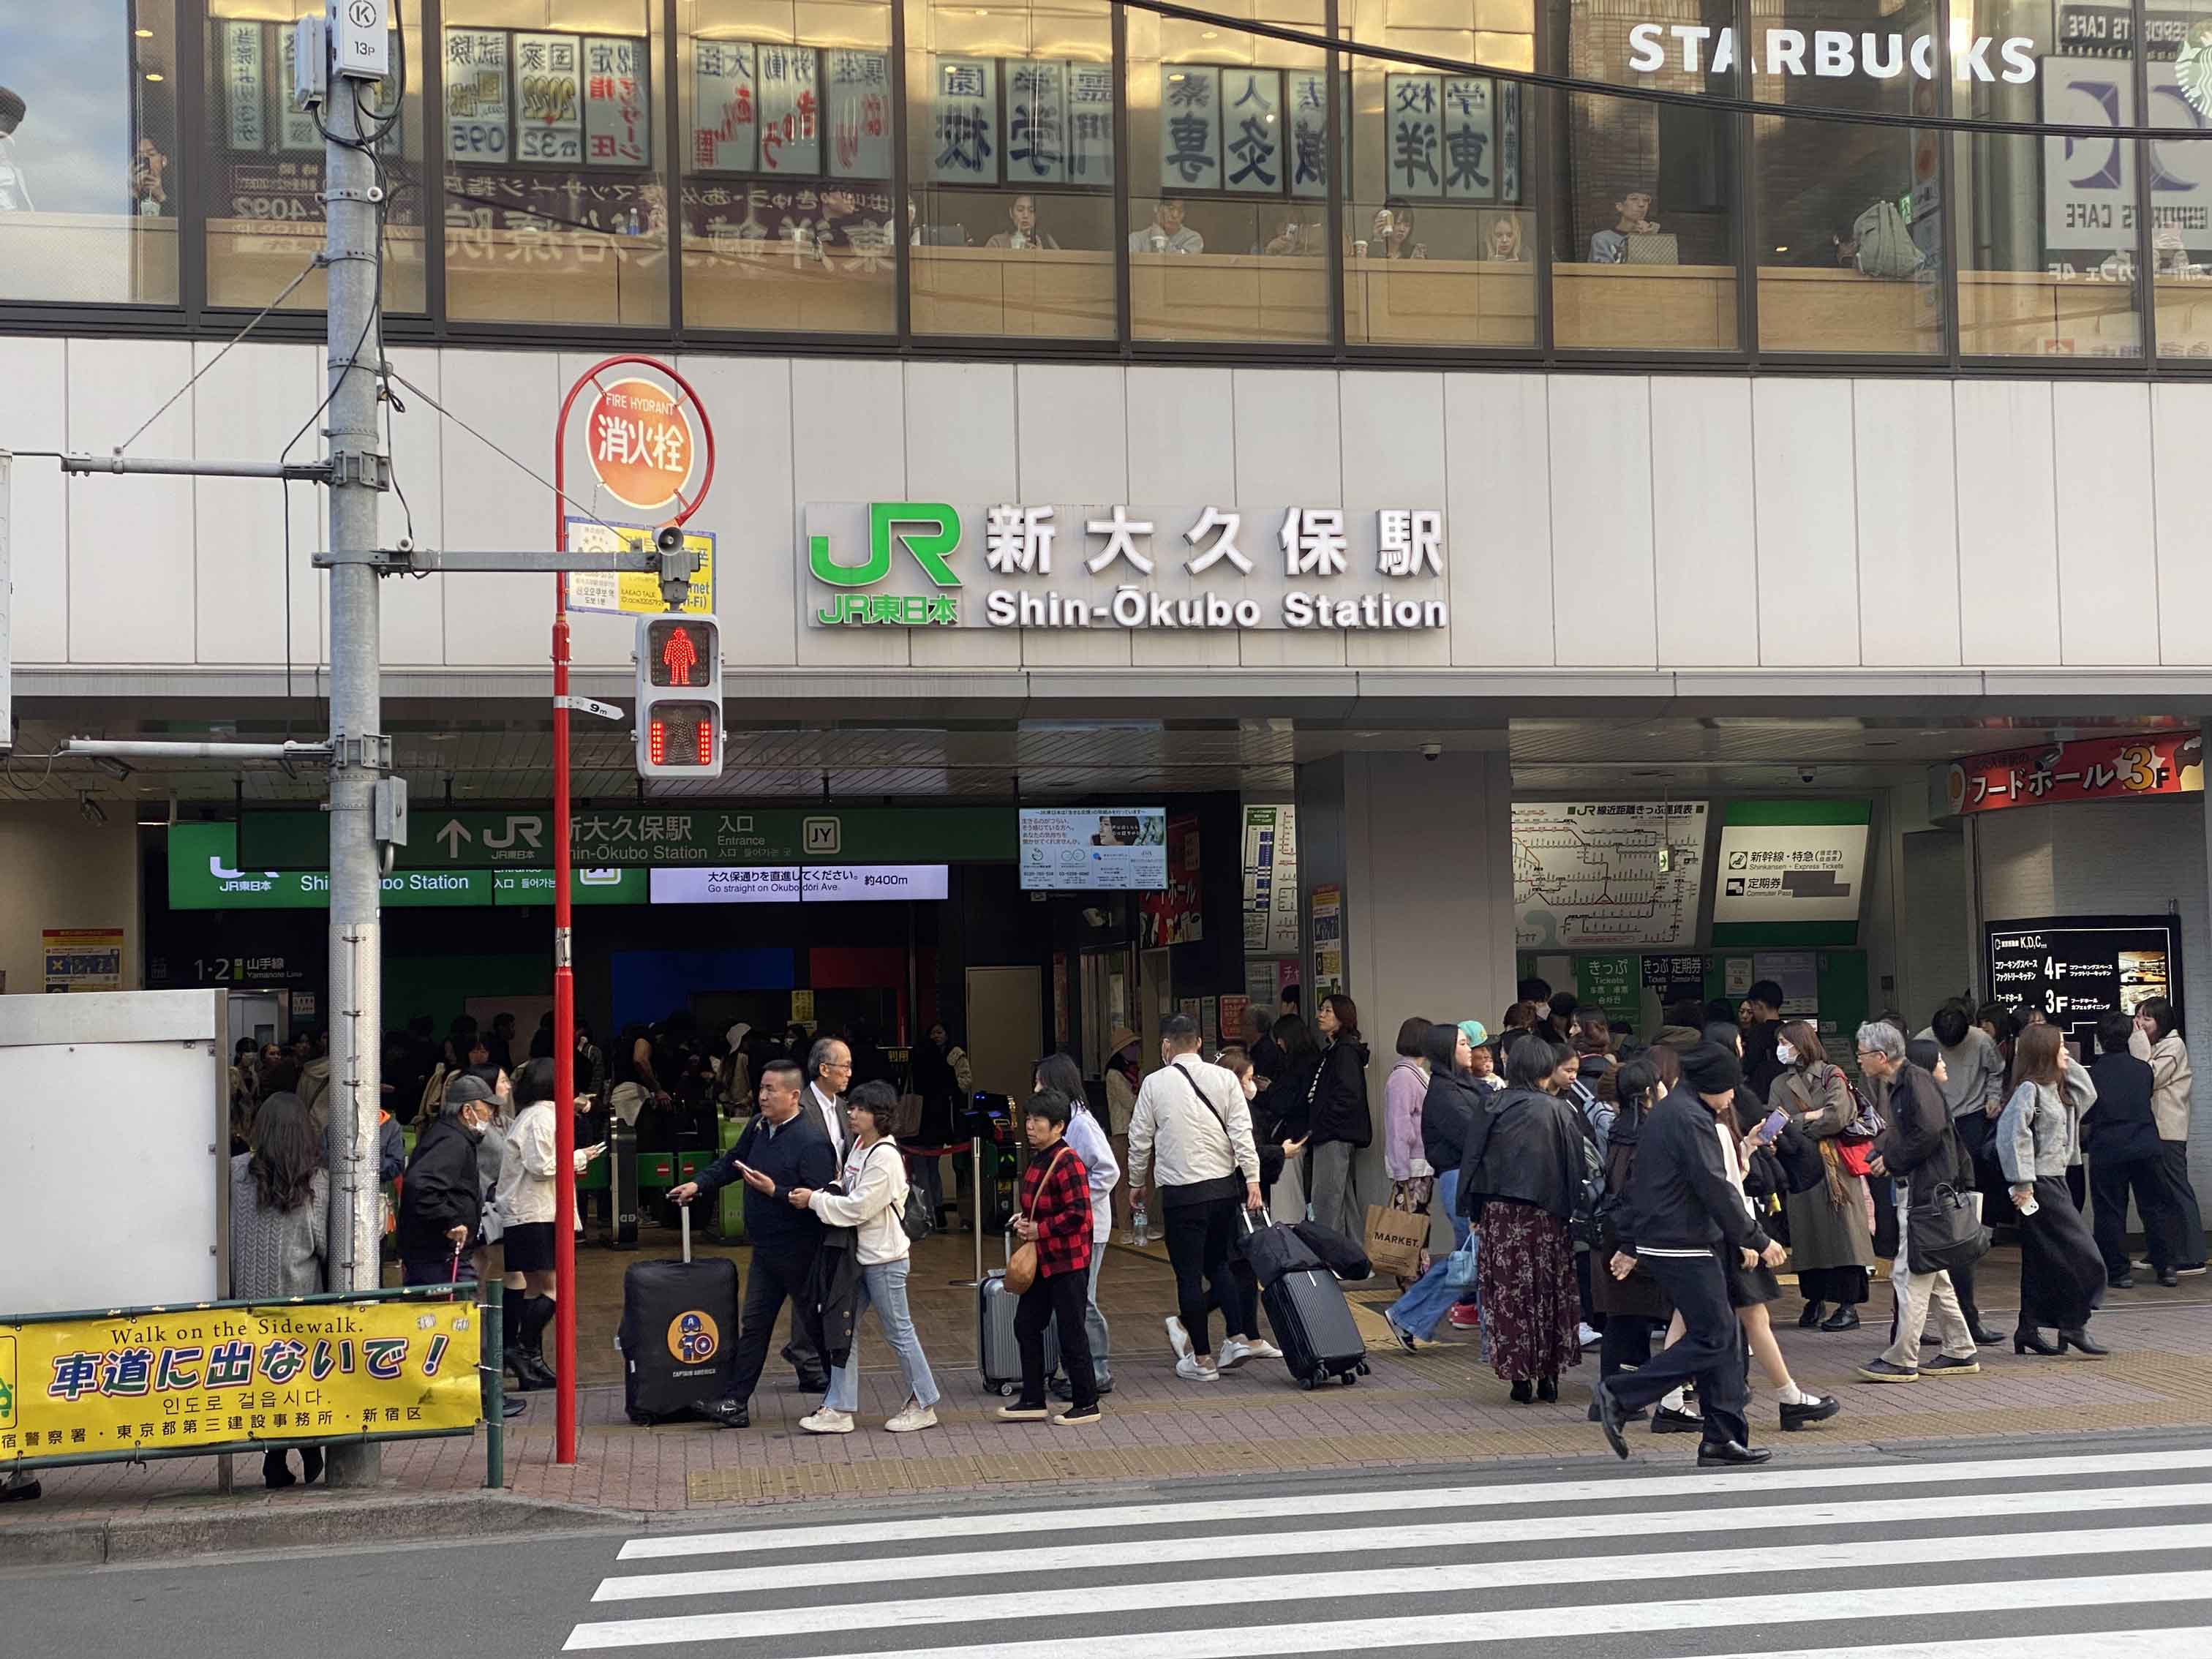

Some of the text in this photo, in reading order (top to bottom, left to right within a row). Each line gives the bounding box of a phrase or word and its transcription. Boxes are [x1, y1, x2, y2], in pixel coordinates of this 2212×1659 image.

[606, 392, 675, 416] FIRE HYDRANT
[597, 413, 685, 473] 消火栓
[808, 502, 963, 587] JR
[985, 502, 1445, 578] 新大久保駅
[817, 591, 960, 627] JR東日本
[985, 584, 1449, 630] Shin-Ōkubo Station
[589, 703, 608, 716] 9m
[1971, 763, 2115, 803] フードホール
[2122, 745, 2170, 791] 3F
[484, 816, 543, 849] JR
[718, 816, 754, 833] 入口
[811, 827, 832, 843] JY
[653, 845, 708, 860] Station
[718, 836, 765, 846] Entrance
[219, 880, 272, 892] JR東日本
[409, 875, 469, 891] Station
[708, 884, 721, 893] Go
[723, 883, 756, 895] straight
[1748, 877, 1781, 889] 定期券
[1589, 958, 1628, 976] きっぷ
[2044, 955, 2067, 980] 4F
[2045, 989, 2069, 1014] 3F
[111, 1317, 365, 1346] Walk on the Sidewalk.
[162, 1393, 223, 1416] 인도로
